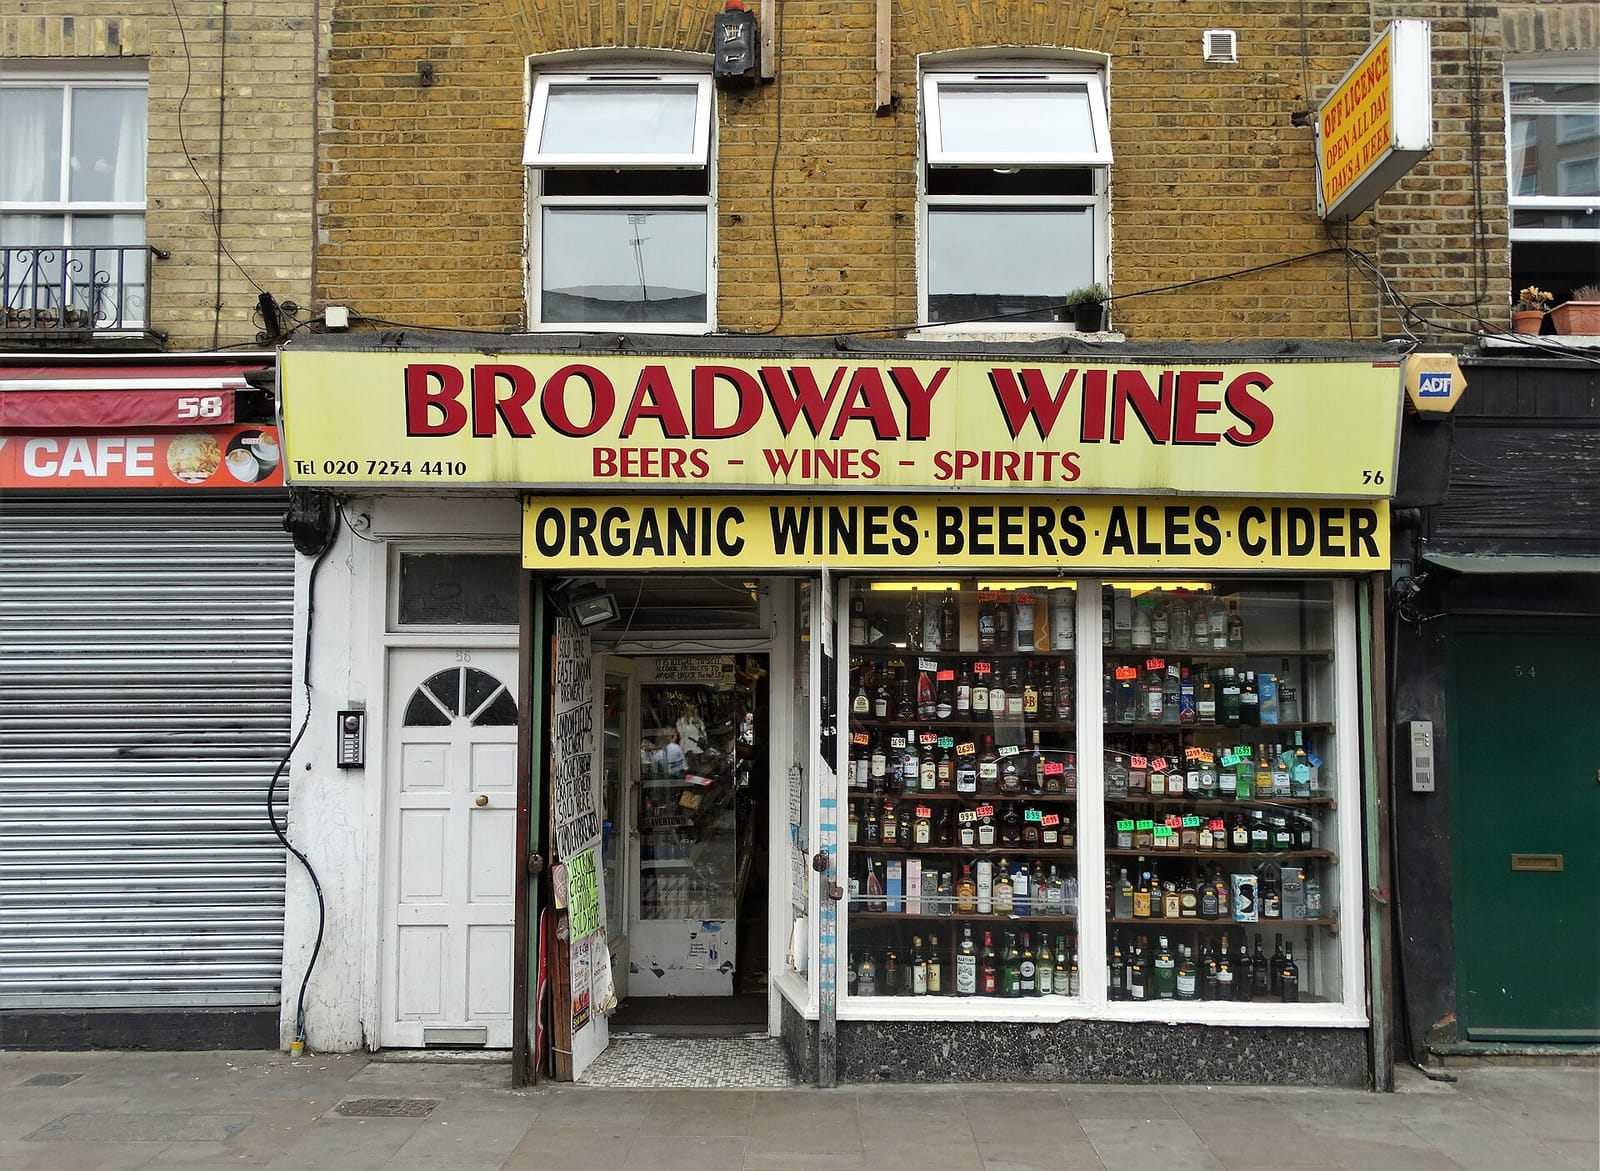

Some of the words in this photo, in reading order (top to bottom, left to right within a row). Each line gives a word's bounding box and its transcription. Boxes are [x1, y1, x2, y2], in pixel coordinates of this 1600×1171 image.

[1324, 99, 1342, 138] OFF
[1345, 47, 1388, 118] LICENCE
[1326, 130, 1349, 170] OPEN
[1351, 110, 1368, 146] ALL
[1370, 88, 1388, 126] DAY
[1325, 183, 1330, 202] 7
[1331, 160, 1353, 197] DAYS
[1354, 152, 1360, 176] A
[1362, 120, 1390, 165] WEEK
[1419, 377, 1452, 394] ADT
[177, 397, 223, 418] 58
[404, 364, 951, 441] BROADWAY
[987, 368, 1275, 447] WINES
[23, 438, 155, 478] CAFE
[294, 460, 316, 475] Tel
[323, 460, 359, 475] 020
[366, 461, 413, 475] 7254
[420, 461, 467, 476] 4410
[592, 447, 711, 479] BEERS
[763, 448, 882, 479] WINES
[933, 450, 1081, 482] SPIRITS
[1362, 470, 1385, 485] 56
[535, 506, 746, 557] ORGANIC
[1238, 506, 1380, 557] CIDER
[558, 660, 573, 684] EAST
[558, 797, 575, 824] SOLD
